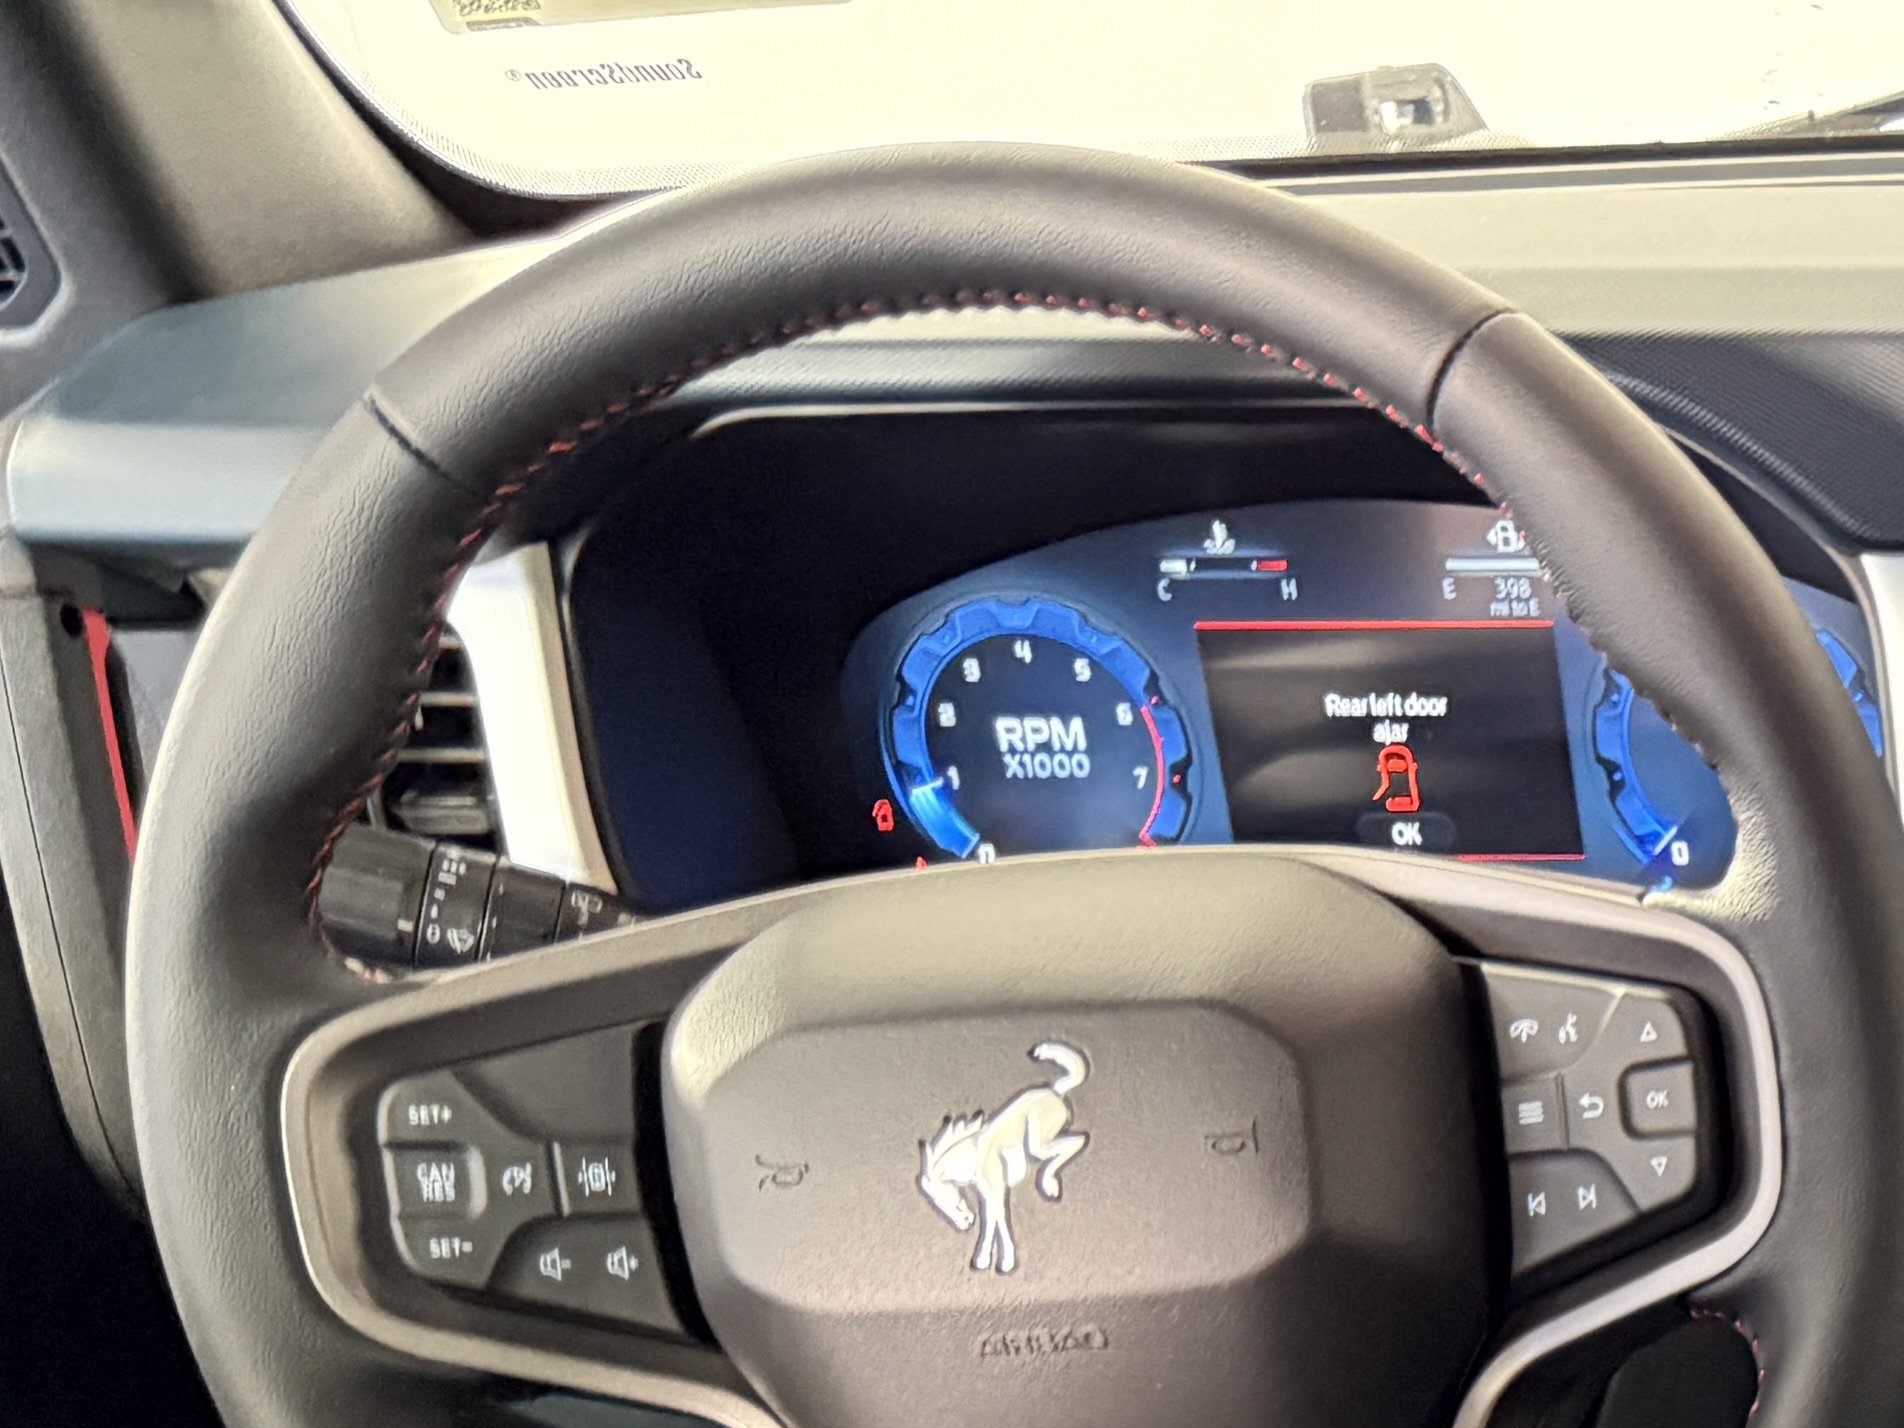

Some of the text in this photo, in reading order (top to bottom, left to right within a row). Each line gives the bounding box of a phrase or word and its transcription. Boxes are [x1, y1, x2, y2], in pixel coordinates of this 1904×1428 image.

[1157, 579, 1172, 602] C
[1280, 578, 1297, 601] H
[1442, 577, 1457, 600] E
[1013, 639, 1032, 664] 4
[962, 657, 981, 683] 3
[1073, 657, 1092, 683] 5
[938, 701, 956, 727] 2
[1115, 701, 1134, 727] 6
[1324, 692, 1448, 717] Rear left door
[994, 717, 1088, 752] RPM
[1372, 721, 1410, 746] ajar
[947, 765, 960, 790] 1
[1004, 753, 1091, 778] X1000
[1132, 766, 1149, 789] 7
[1391, 821, 1423, 846] OK
[1670, 841, 1690, 866] 0
[1646, 1089, 1669, 1110] OK
